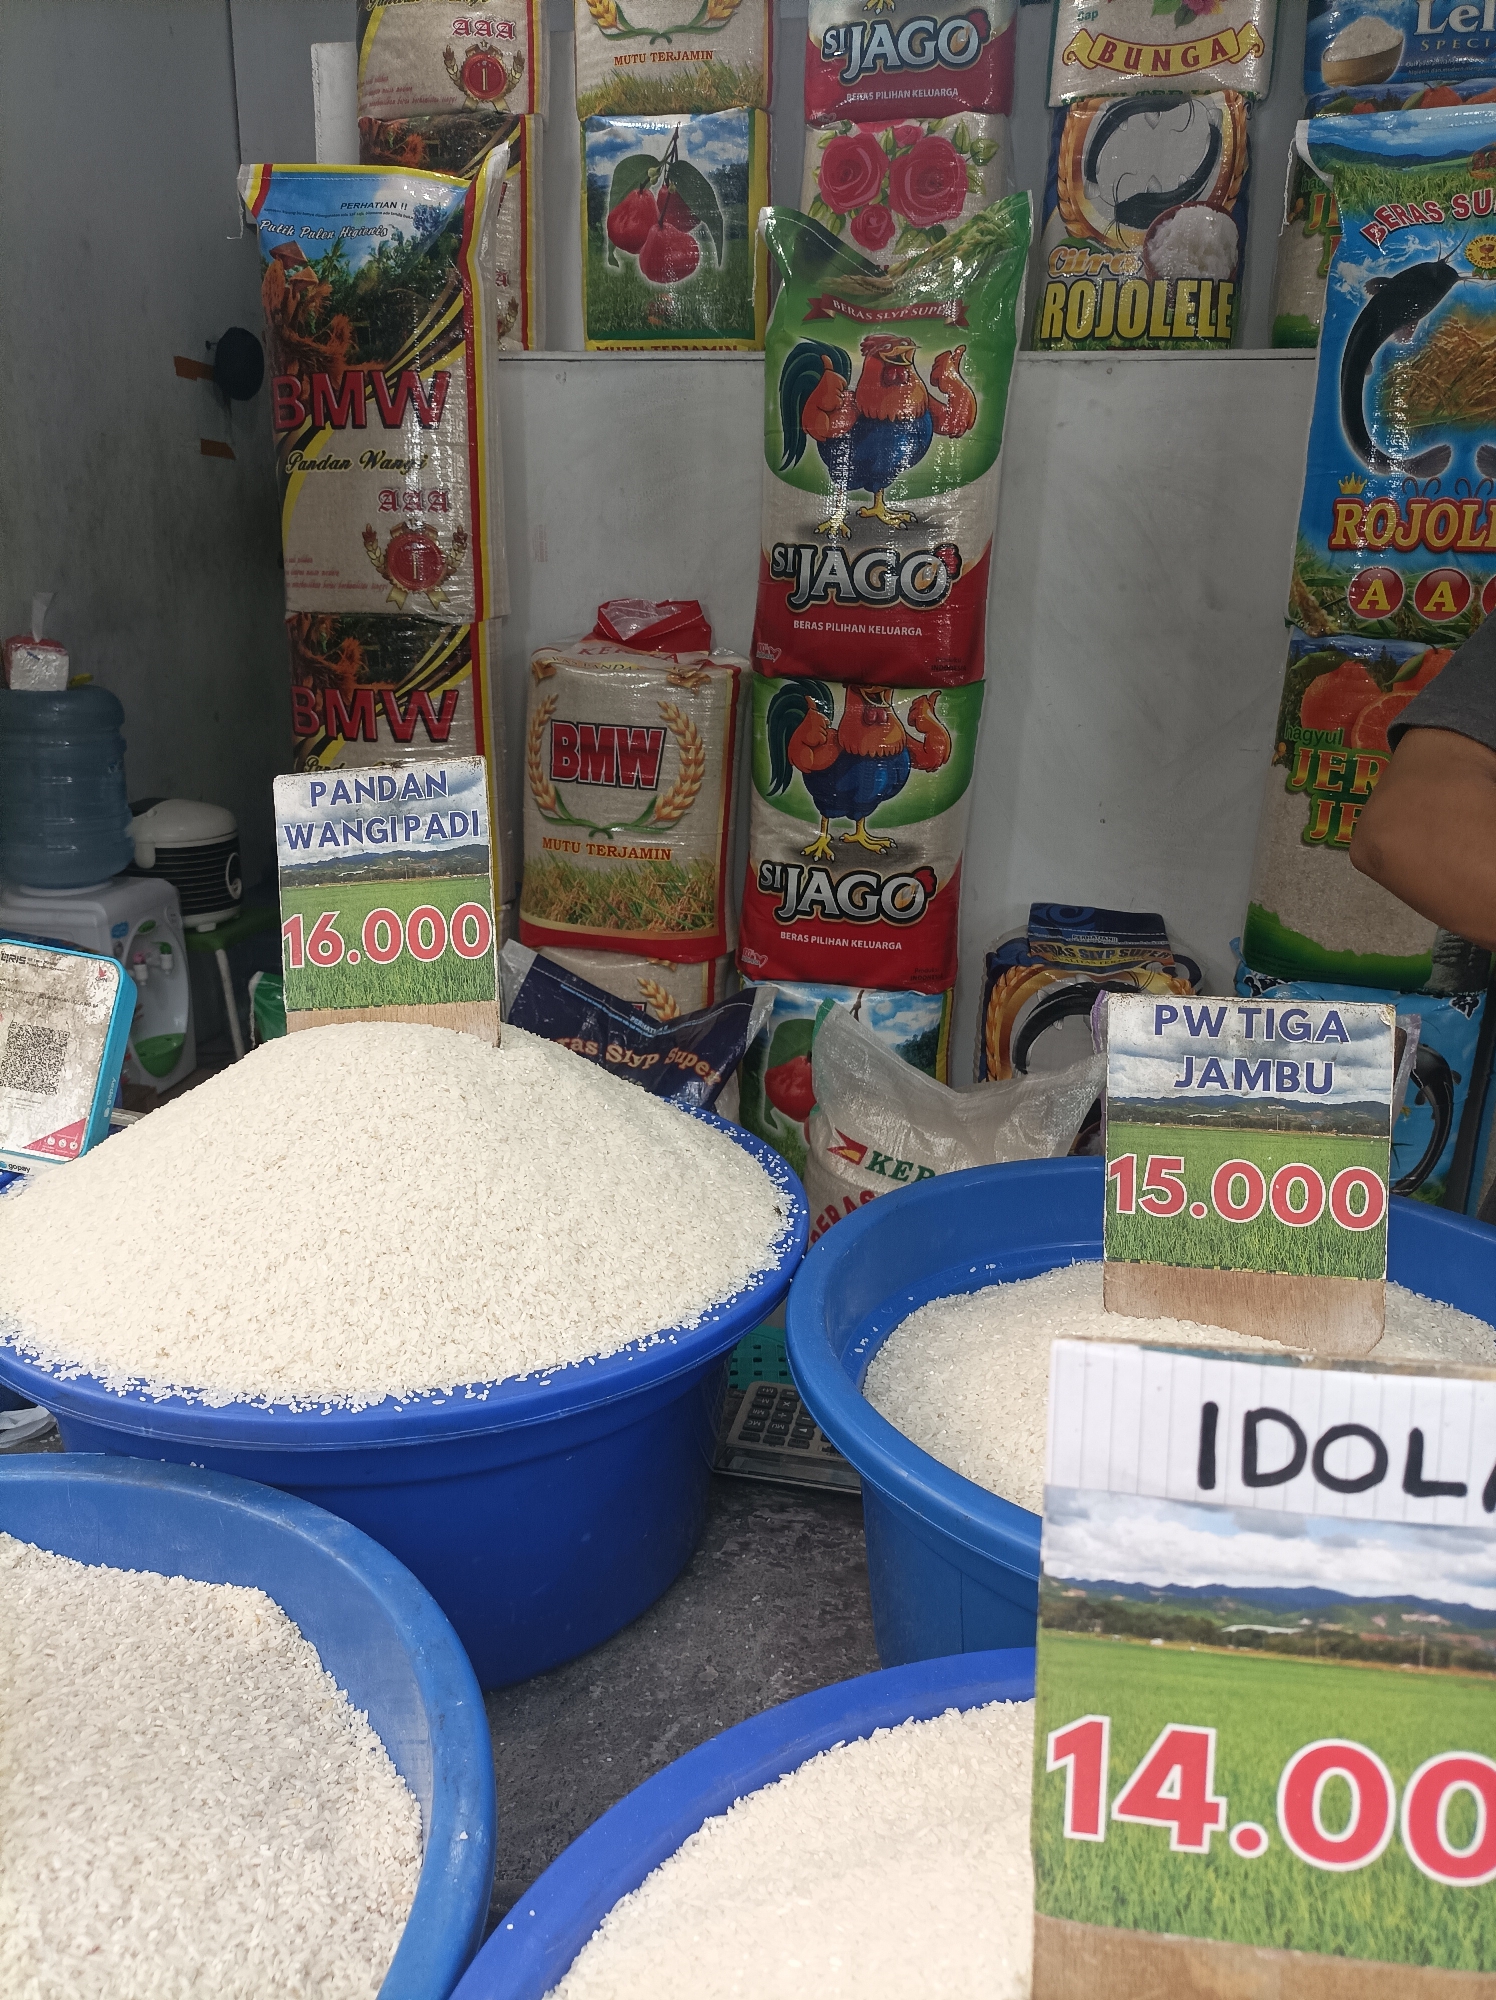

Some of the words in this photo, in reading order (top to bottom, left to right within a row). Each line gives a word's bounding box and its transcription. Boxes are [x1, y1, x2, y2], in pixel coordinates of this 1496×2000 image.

[614, 53, 646, 66] MUTU
[650, 50, 714, 63] TERJAMIN
[824, 31, 846, 56] SI
[843, 18, 980, 80] JAGO
[1101, 38, 1230, 72] BUNGA
[847, 92, 873, 102] BERAS
[876, 90, 910, 100] PILIHAN
[912, 88, 958, 98] KELUARGA
[340, 202, 397, 210] PERHATIAN
[260, 220, 295, 236] Putih
[300, 226, 335, 240] Pulen
[340, 224, 389, 239] Higienis
[1360, 202, 1444, 246] BERAS
[1047, 247, 1143, 278] Citra
[833, 299, 873, 320] BERAS
[875, 309, 910, 320] SLYP
[1041, 280, 1234, 341] ROJOLELE
[272, 370, 451, 430] BMW
[285, 451, 352, 474] Pandan
[773, 544, 795, 572] SI
[791, 548, 947, 604] JAGO
[1357, 579, 1391, 610] A
[1423, 581, 1457, 612] A
[793, 620, 824, 631] BERAS
[825, 622, 866, 633] PILIHAN
[868, 624, 923, 636] KELUARGA
[291, 687, 459, 743] BMW
[551, 722, 666, 790] BMW
[310, 770, 449, 807] PANDAN
[542, 837, 581, 854] MUTU
[585, 844, 672, 861] TERJAMIN
[761, 863, 781, 888] SI
[778, 865, 925, 920] JAGO
[282, 902, 493, 968] 16.000
[780, 932, 809, 943] BERAS
[811, 934, 849, 947] PILIHAN
[851, 938, 902, 950] KELUARGA
[1030, 942, 1076, 958] BERAS
[1118, 948, 1172, 961] SUPER
[1154, 1004, 1227, 1039] PW
[1237, 1007, 1351, 1044] TIGA
[604, 1043, 660, 1070] Slyp
[663, 1046, 722, 1086] Super
[1174, 1055, 1335, 1095] JAMBU
[8, 1163, 31, 1174] gopay
[1107, 1153, 1387, 1232] 15.000
[1046, 1714, 1496, 1888] 14.00
